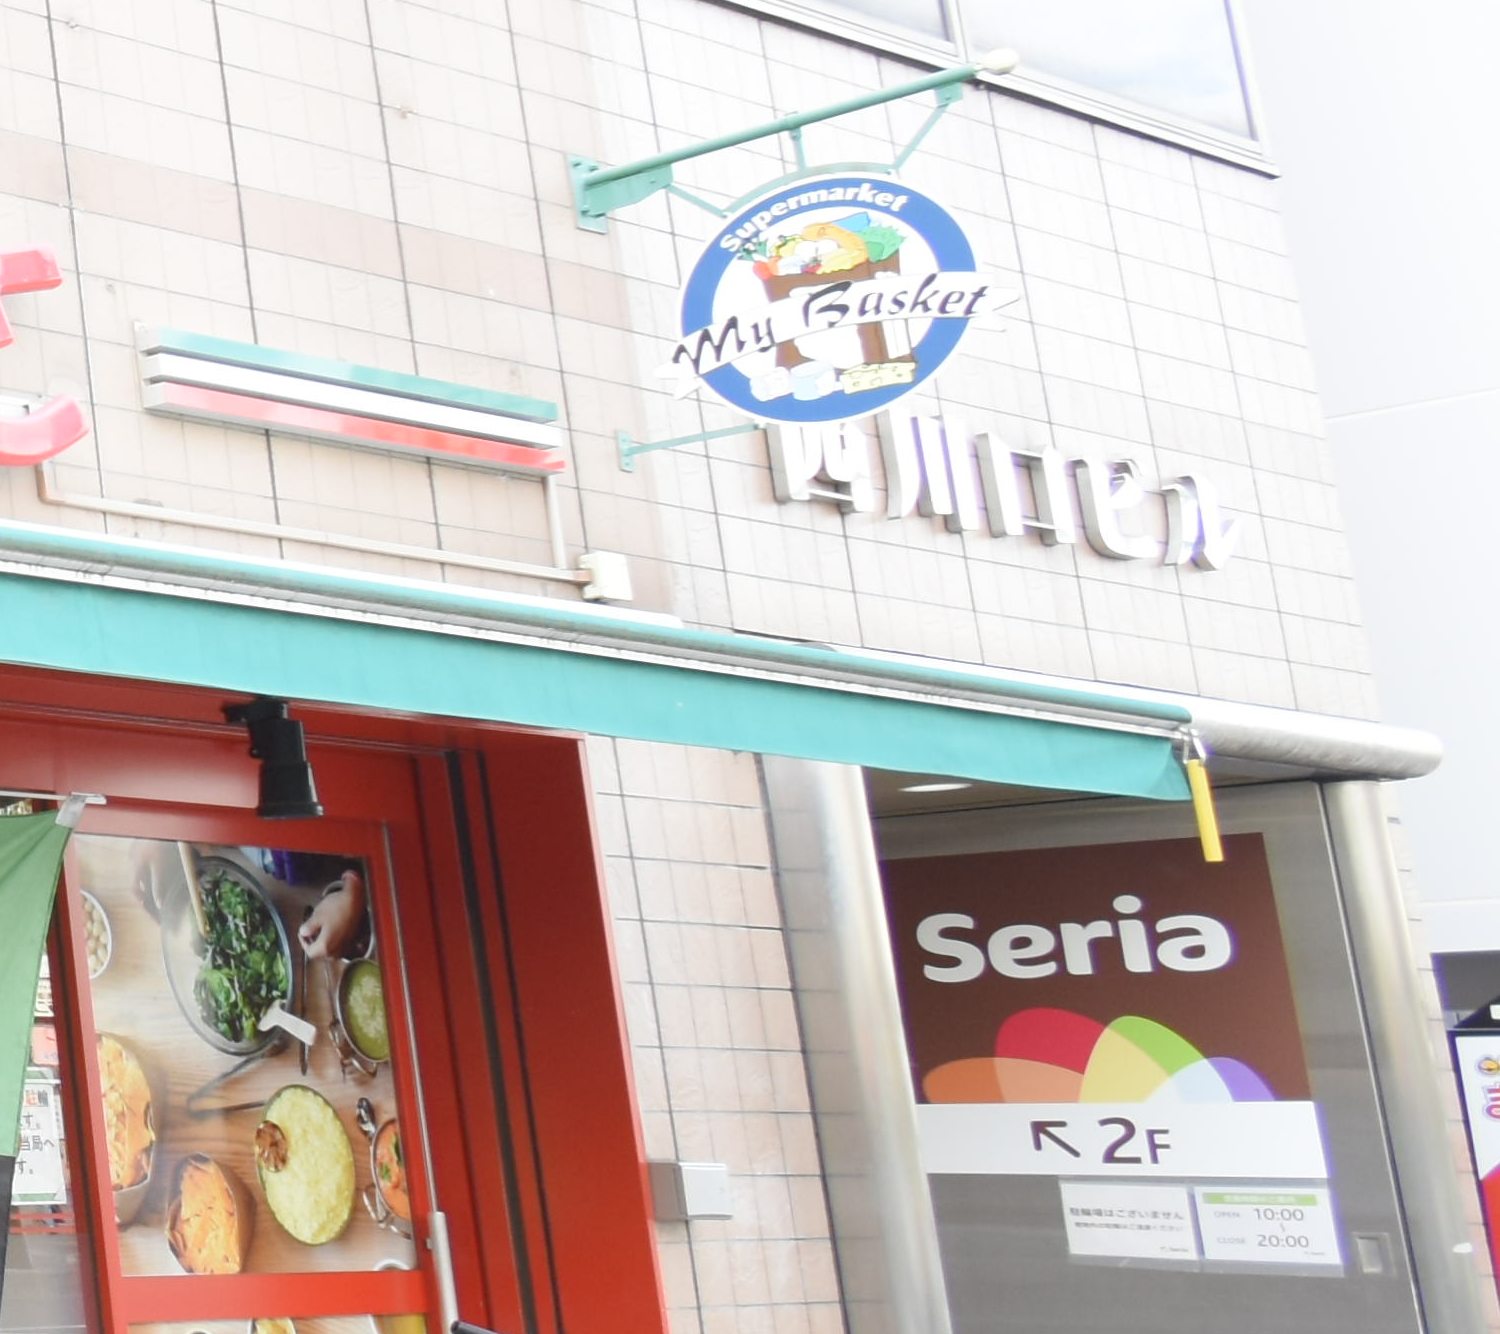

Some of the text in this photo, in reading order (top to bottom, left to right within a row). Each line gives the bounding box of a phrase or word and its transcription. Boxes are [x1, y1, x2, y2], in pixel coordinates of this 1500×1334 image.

[718, 181, 910, 254] Supermarket
[672, 272, 990, 378] My Basket
[914, 893, 1233, 984] Seria
[1097, 1116, 1173, 1165] 2F
[1252, 1207, 1305, 1222] 10:00
[1256, 1234, 1310, 1249] 20:00
